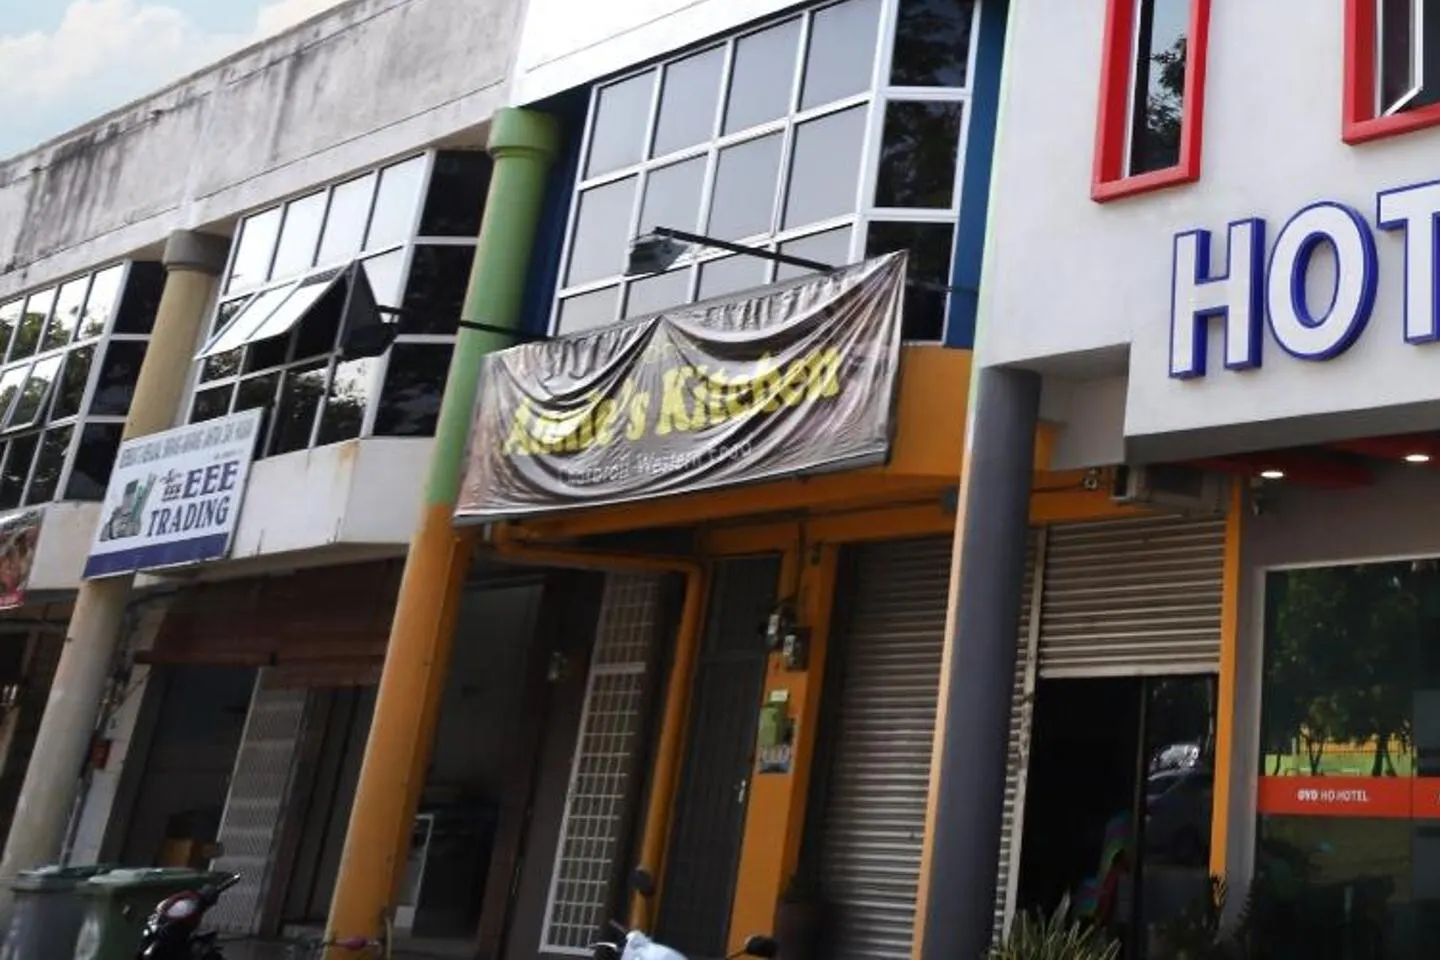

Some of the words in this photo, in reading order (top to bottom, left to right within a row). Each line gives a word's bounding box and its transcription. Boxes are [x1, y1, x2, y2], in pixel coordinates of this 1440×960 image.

[182, 460, 240, 500] EEE
[147, 495, 231, 537] TRADING
[1297, 789, 1318, 801] OYO
[1337, 790, 1369, 803] HOTEL
